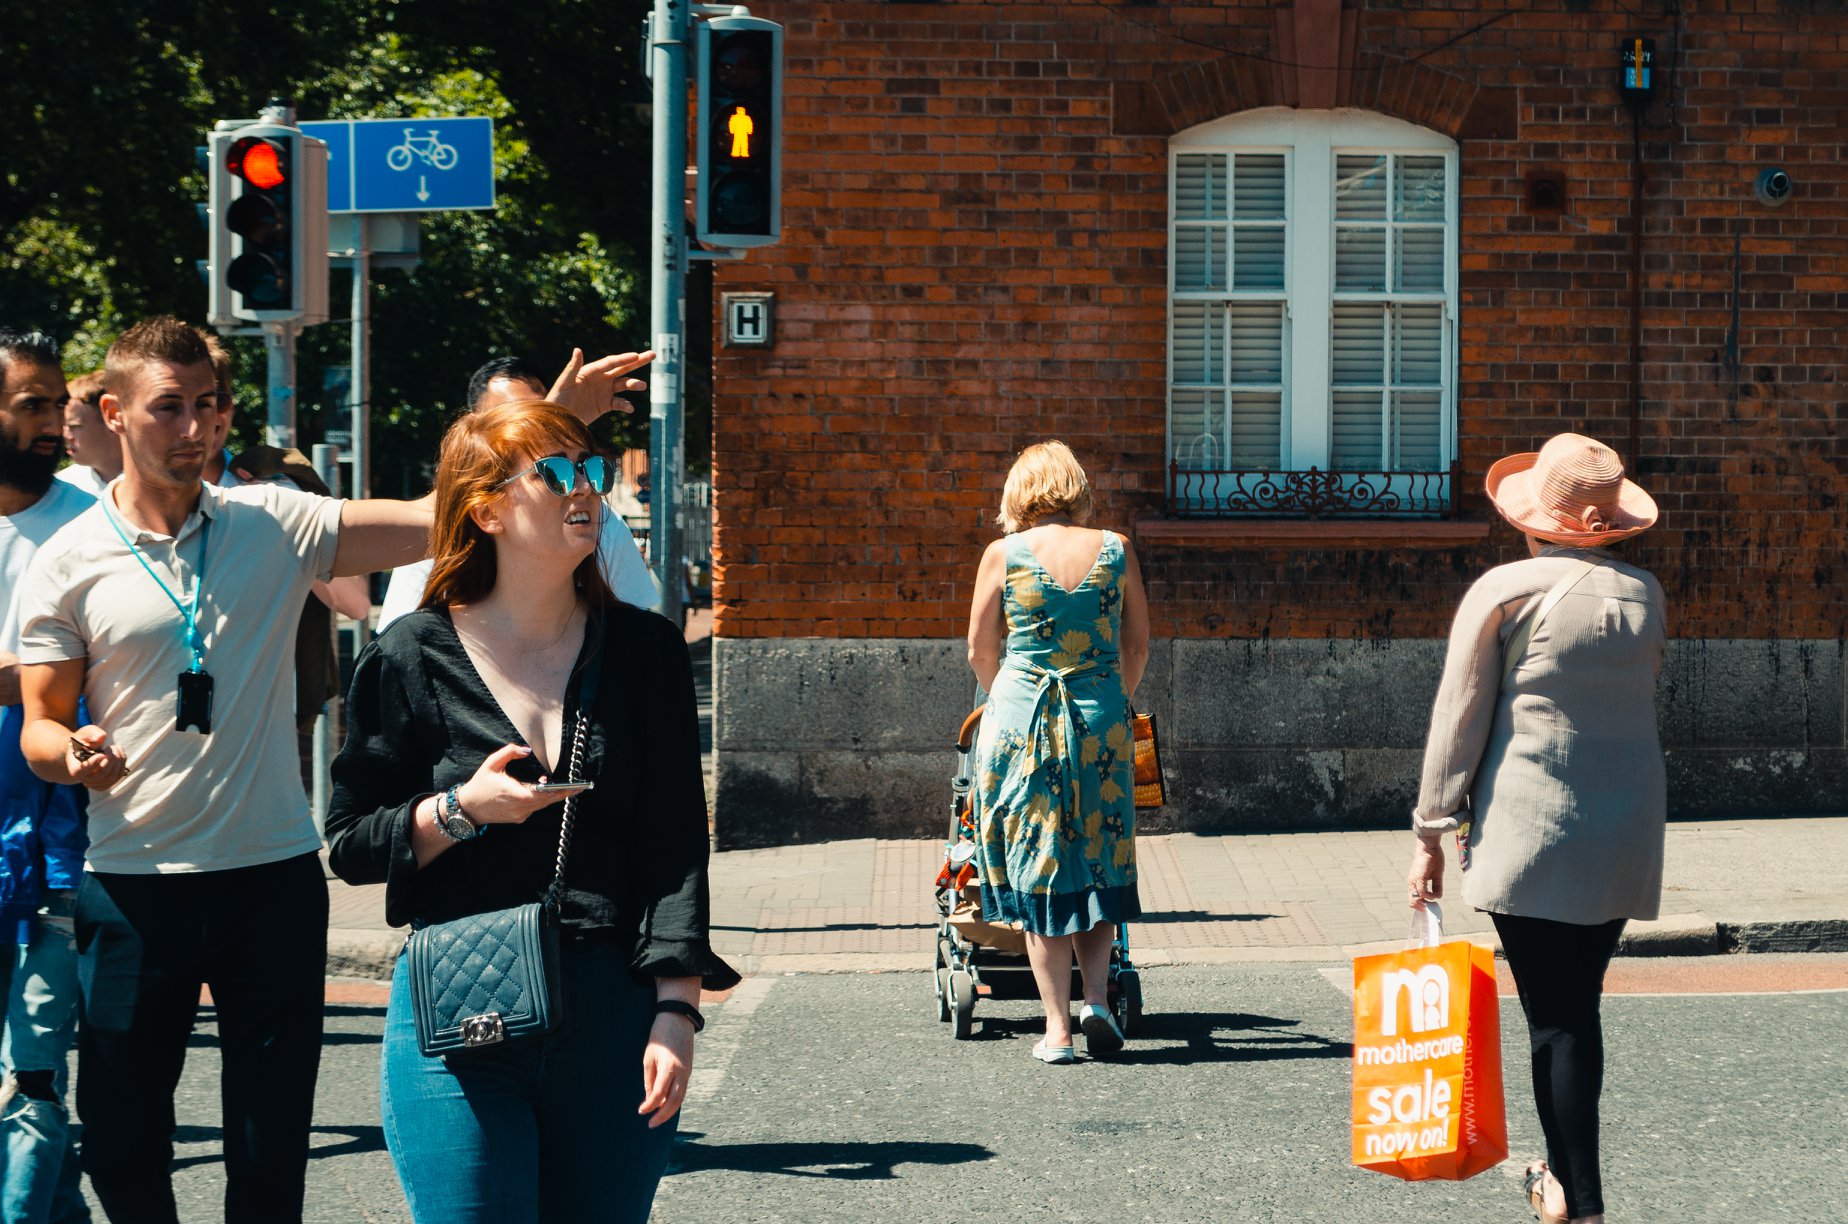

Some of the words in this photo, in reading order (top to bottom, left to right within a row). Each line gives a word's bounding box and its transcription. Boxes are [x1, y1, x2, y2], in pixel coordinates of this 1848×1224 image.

[737, 305, 759, 336] H
[1357, 1035, 1464, 1066] mothercare
[1368, 1068, 1451, 1125] sale
[1366, 1132, 1418, 1156] now
[1420, 1117, 1449, 1151] on!
